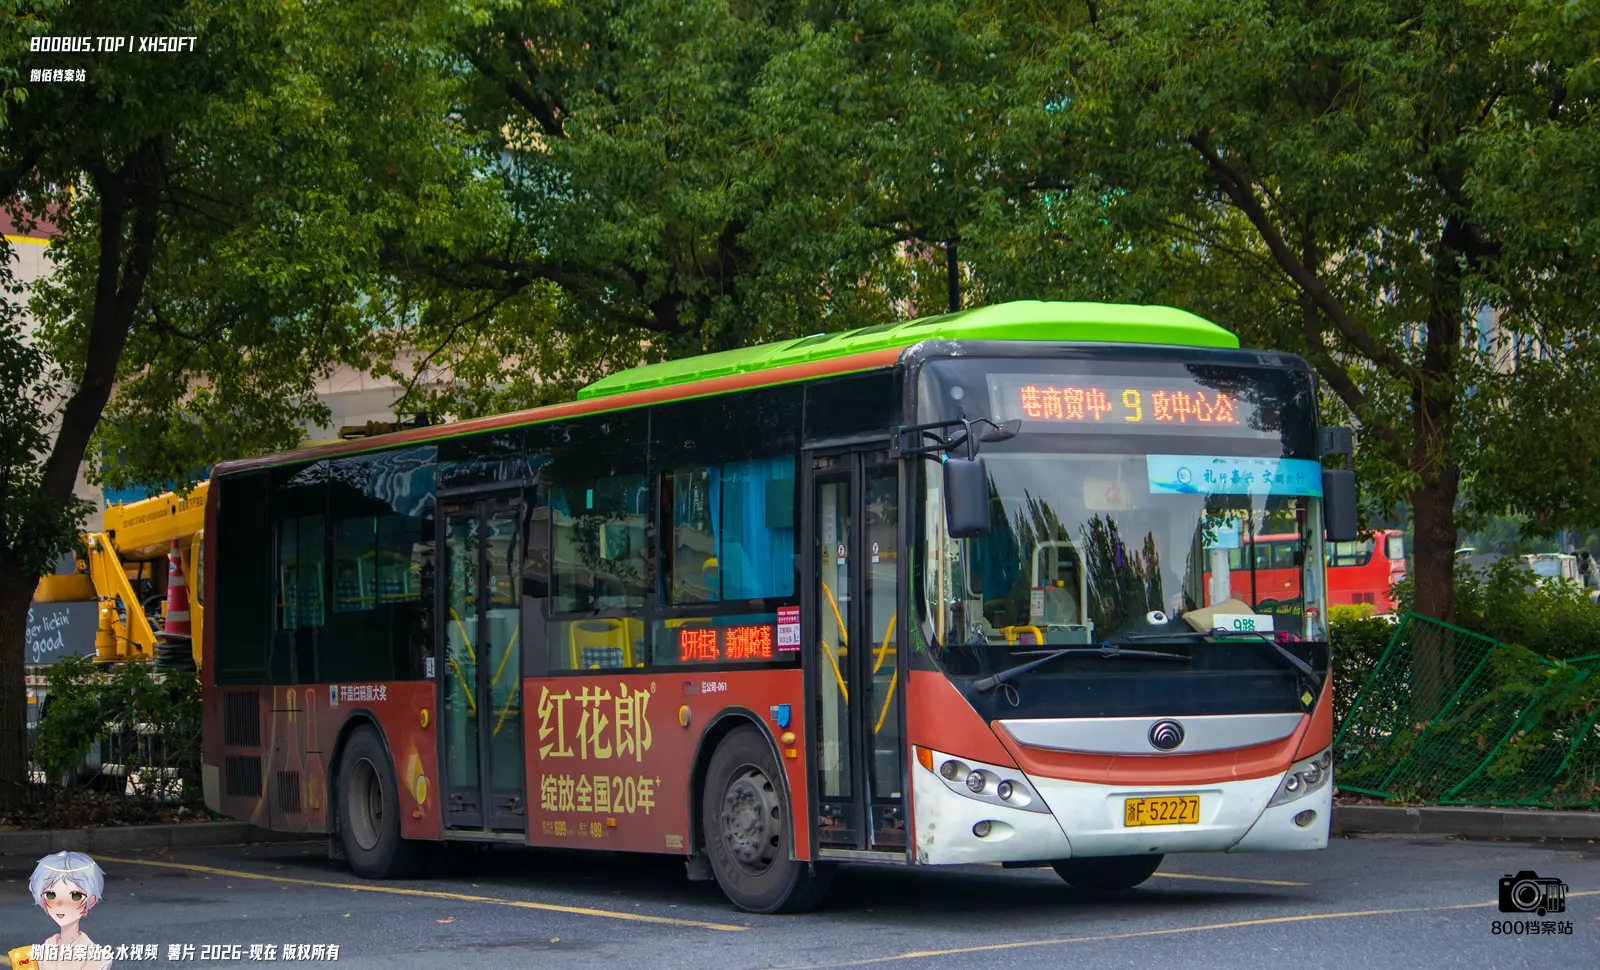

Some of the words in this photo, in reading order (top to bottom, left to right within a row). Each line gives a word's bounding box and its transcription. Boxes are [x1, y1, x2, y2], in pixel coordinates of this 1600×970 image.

[1122, 389, 1143, 422] 9
[1233, 618, 1256, 632] 9路
[32, 630, 65, 664] good
[340, 684, 387, 702] 开盖扫码赢大奖
[537, 682, 652, 763] 红花郎
[554, 820, 567, 836] 699
[590, 821, 602, 838] 499
